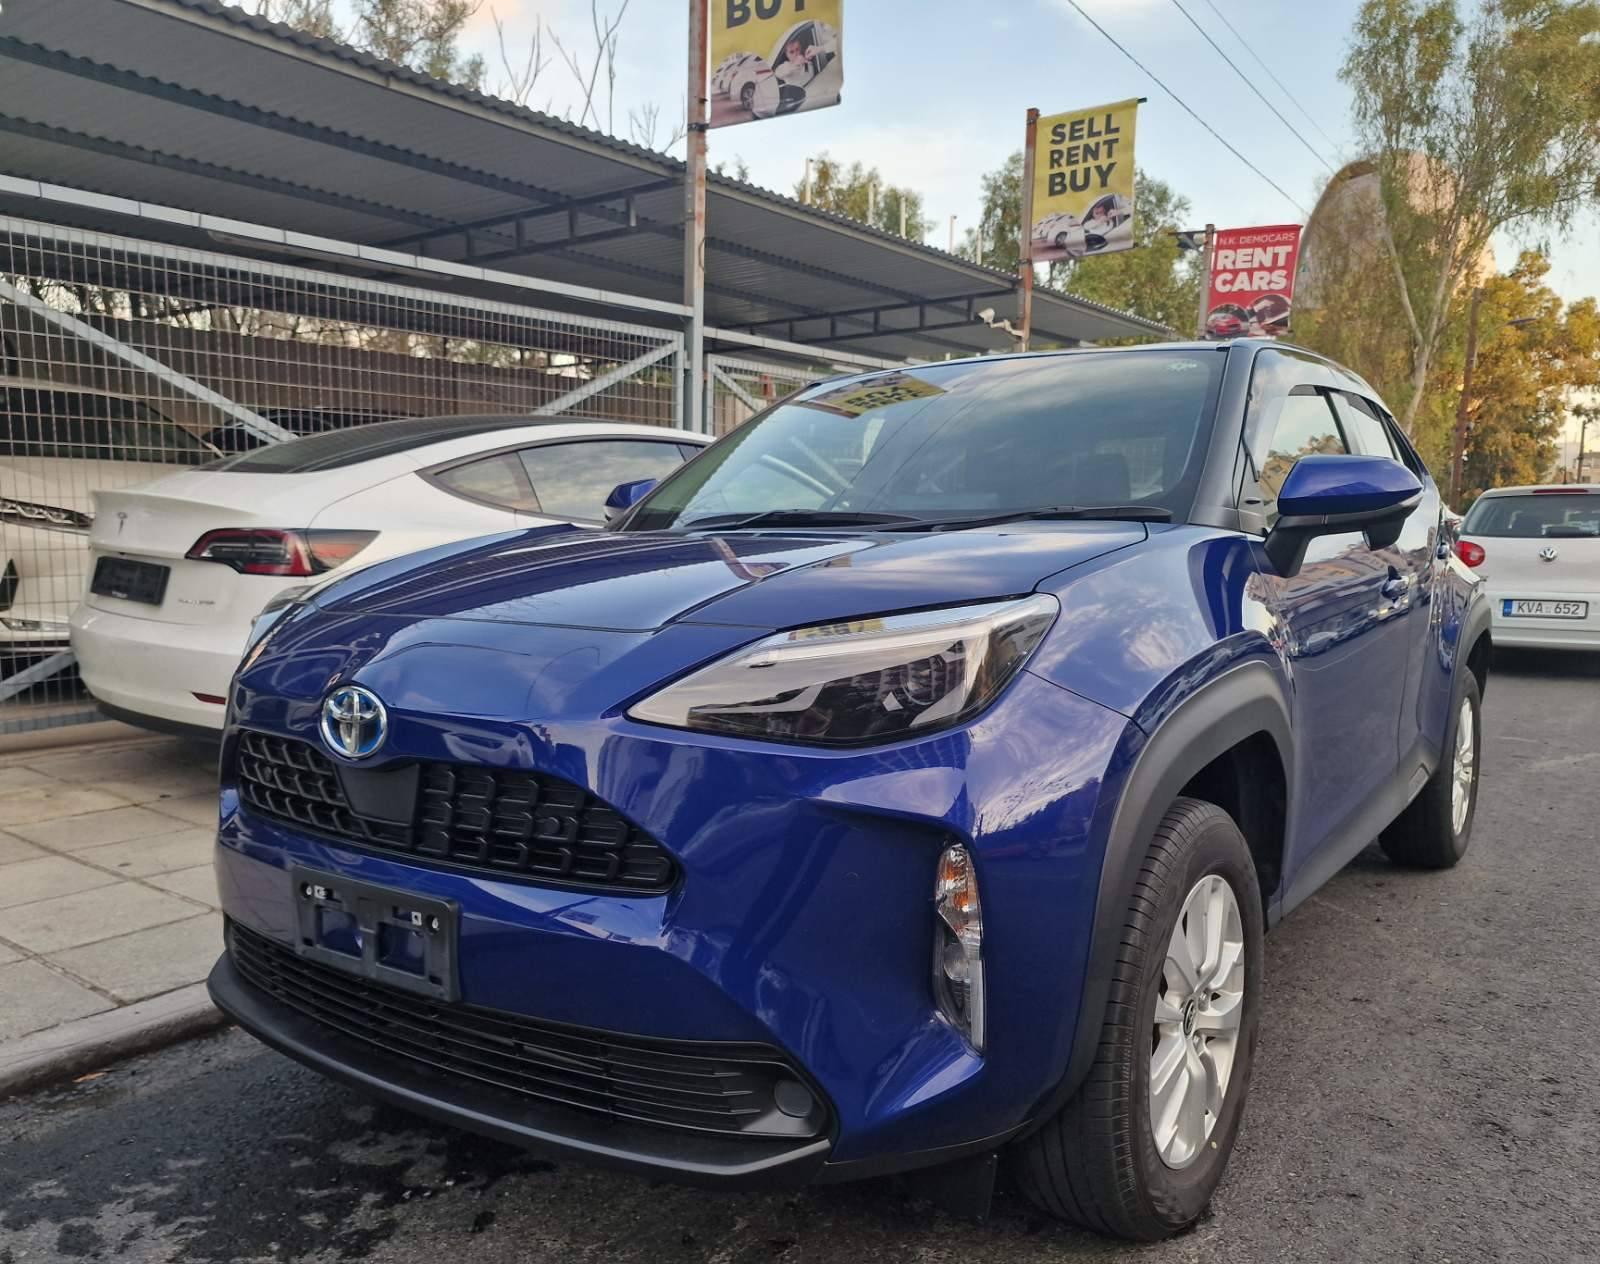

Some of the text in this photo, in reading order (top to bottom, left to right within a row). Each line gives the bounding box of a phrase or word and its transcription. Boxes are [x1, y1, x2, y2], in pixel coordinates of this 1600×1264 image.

[1050, 113, 1120, 144] SELL
[1050, 138, 1119, 169] RENT
[1048, 162, 1117, 197] BUY
[1216, 246, 1293, 270] RENT
[1215, 269, 1288, 293] CARS
[1517, 602, 1580, 615] KVA 652
